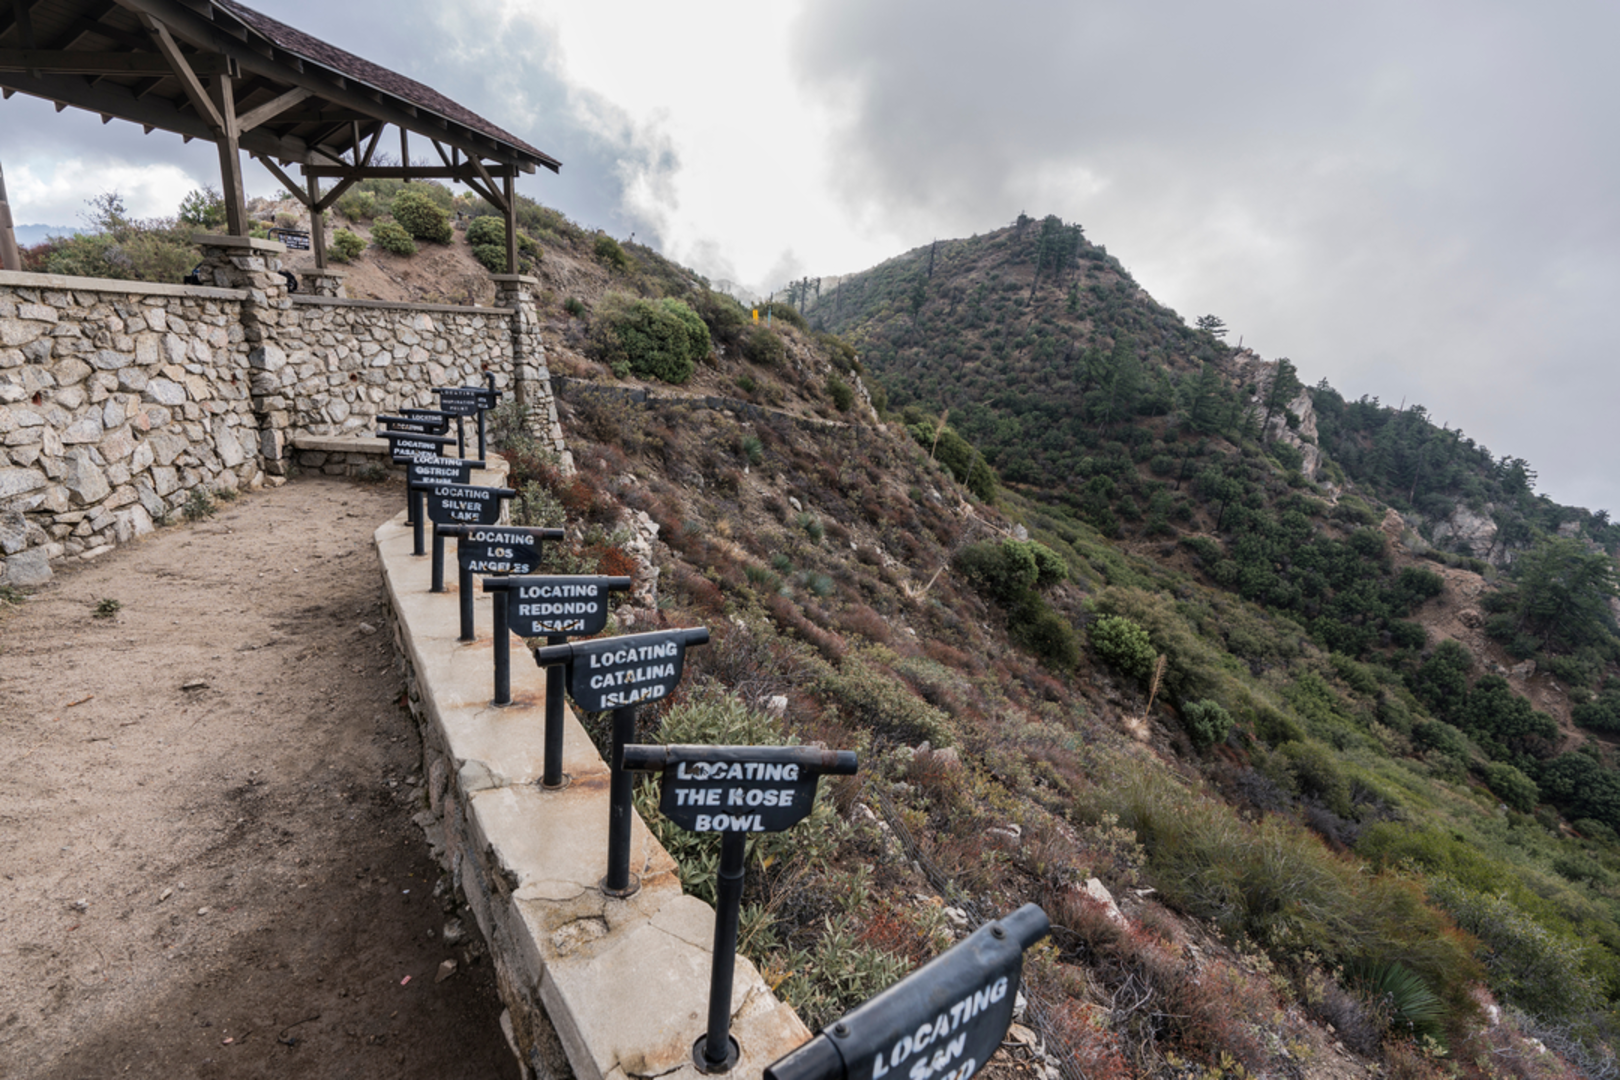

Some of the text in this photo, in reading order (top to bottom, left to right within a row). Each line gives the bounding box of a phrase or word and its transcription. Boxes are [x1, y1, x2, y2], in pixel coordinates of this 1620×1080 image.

[397, 439, 436, 450] LOCATING
[413, 456, 463, 467] LOCATING
[415, 466, 460, 477] OSTRICH
[434, 486, 490, 500] LOCATING
[441, 499, 482, 511] SILVER
[450, 511, 480, 522] LAKE
[468, 531, 535, 546] LOCATING
[487, 547, 514, 559] LOS
[468, 560, 530, 573] ANGELES
[519, 584, 598, 599] LOCATING
[518, 602, 598, 616] REDONDO
[531, 618, 585, 633] BEACH
[590, 641, 678, 669] LOCATING
[590, 662, 676, 690] CATALINA
[600, 684, 666, 709] ISLAND
[677, 761, 800, 781] LOCATING
[675, 786, 795, 807] THE ROSE
[695, 813, 765, 832] BOWL
[872, 976, 1008, 1080] LOCATING
[909, 1032, 967, 1080] SAN
